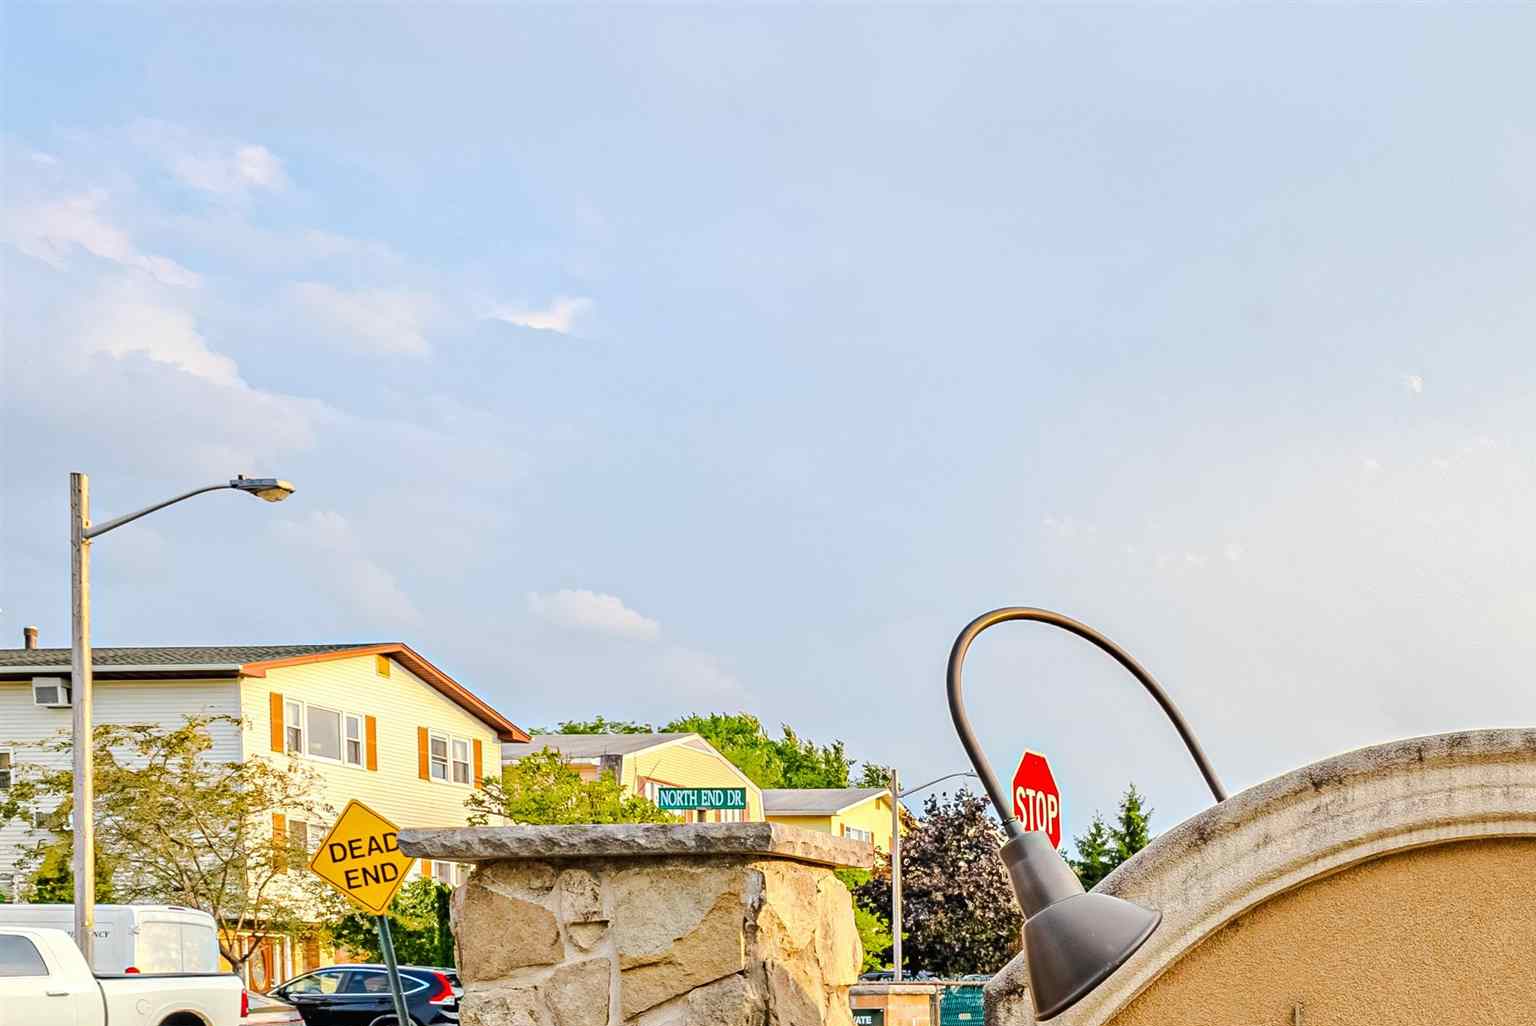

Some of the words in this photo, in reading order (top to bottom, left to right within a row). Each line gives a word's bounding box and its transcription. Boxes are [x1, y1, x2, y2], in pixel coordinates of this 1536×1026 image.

[660, 790, 698, 806] NORTH
[701, 790, 724, 806] END
[727, 790, 745, 806] DR.
[1016, 786, 1057, 834] STOP
[328, 832, 400, 863] DEAD
[344, 862, 399, 889] END
